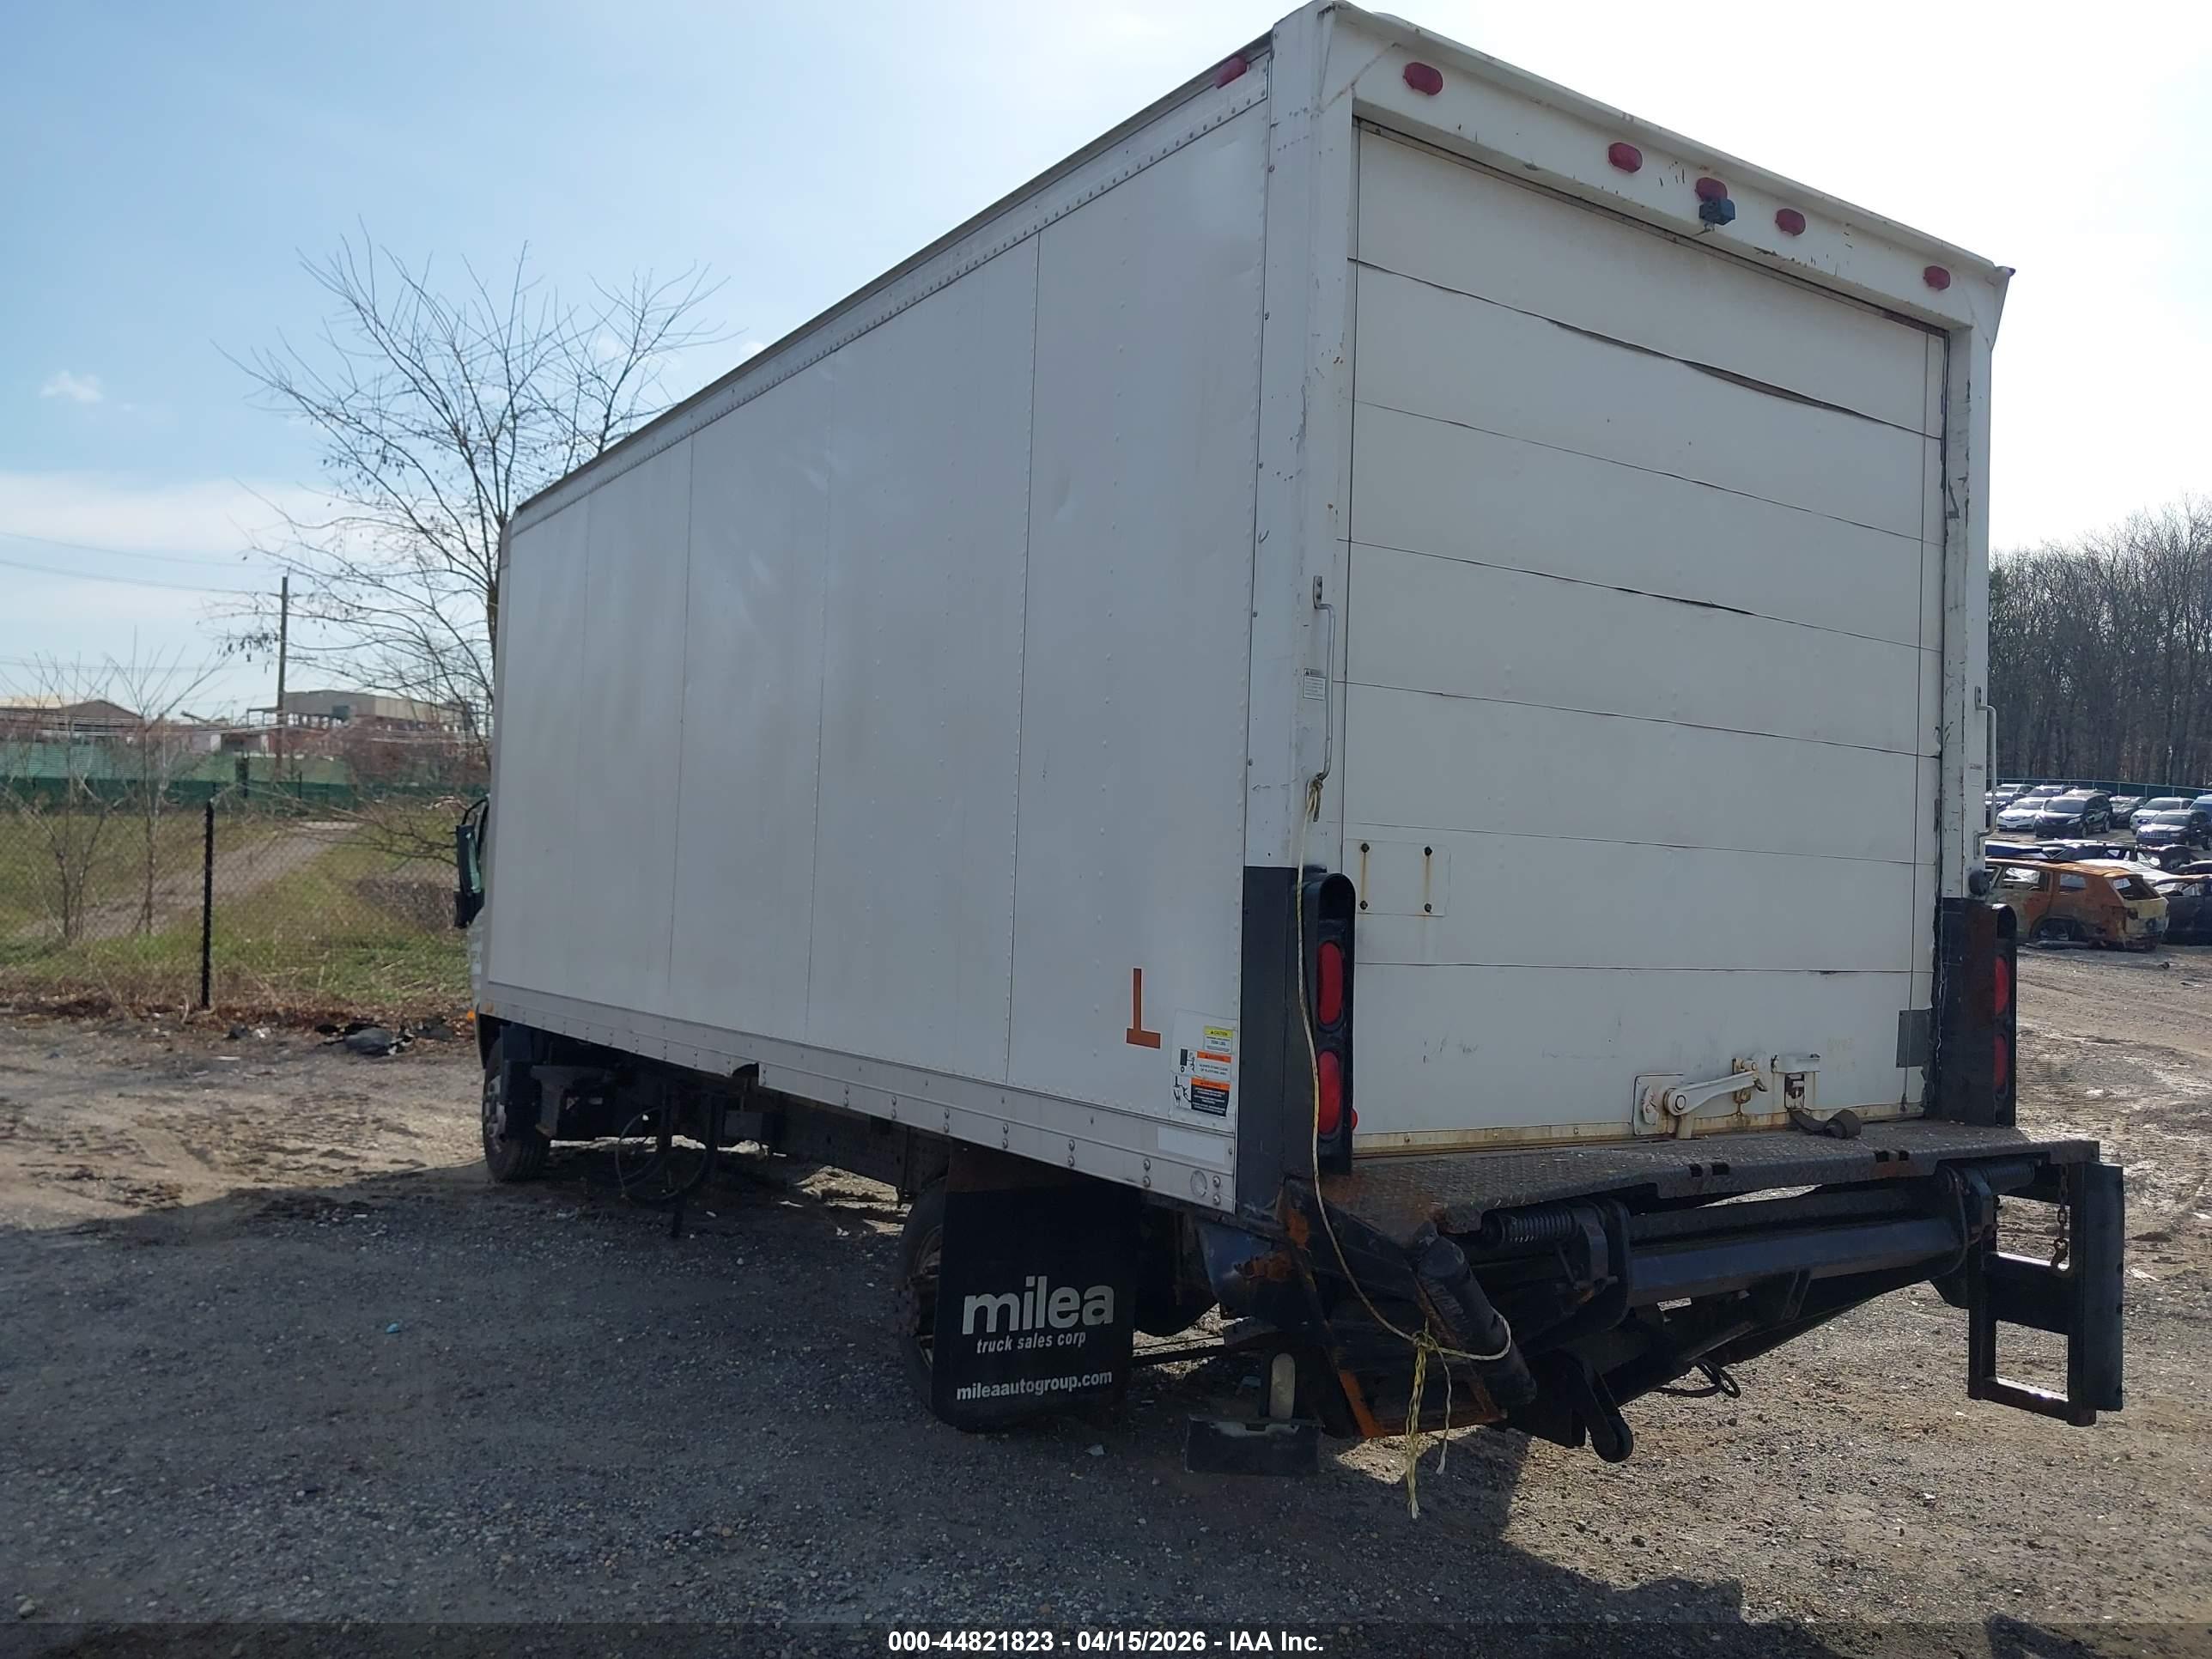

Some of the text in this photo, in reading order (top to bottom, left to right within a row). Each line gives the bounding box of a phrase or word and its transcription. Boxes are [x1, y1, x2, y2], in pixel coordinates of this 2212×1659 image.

[962, 1275, 1115, 1335] milea
[976, 1331, 1086, 1354] truck sales corp
[956, 1370, 1113, 1401] mileaautogroup.com
